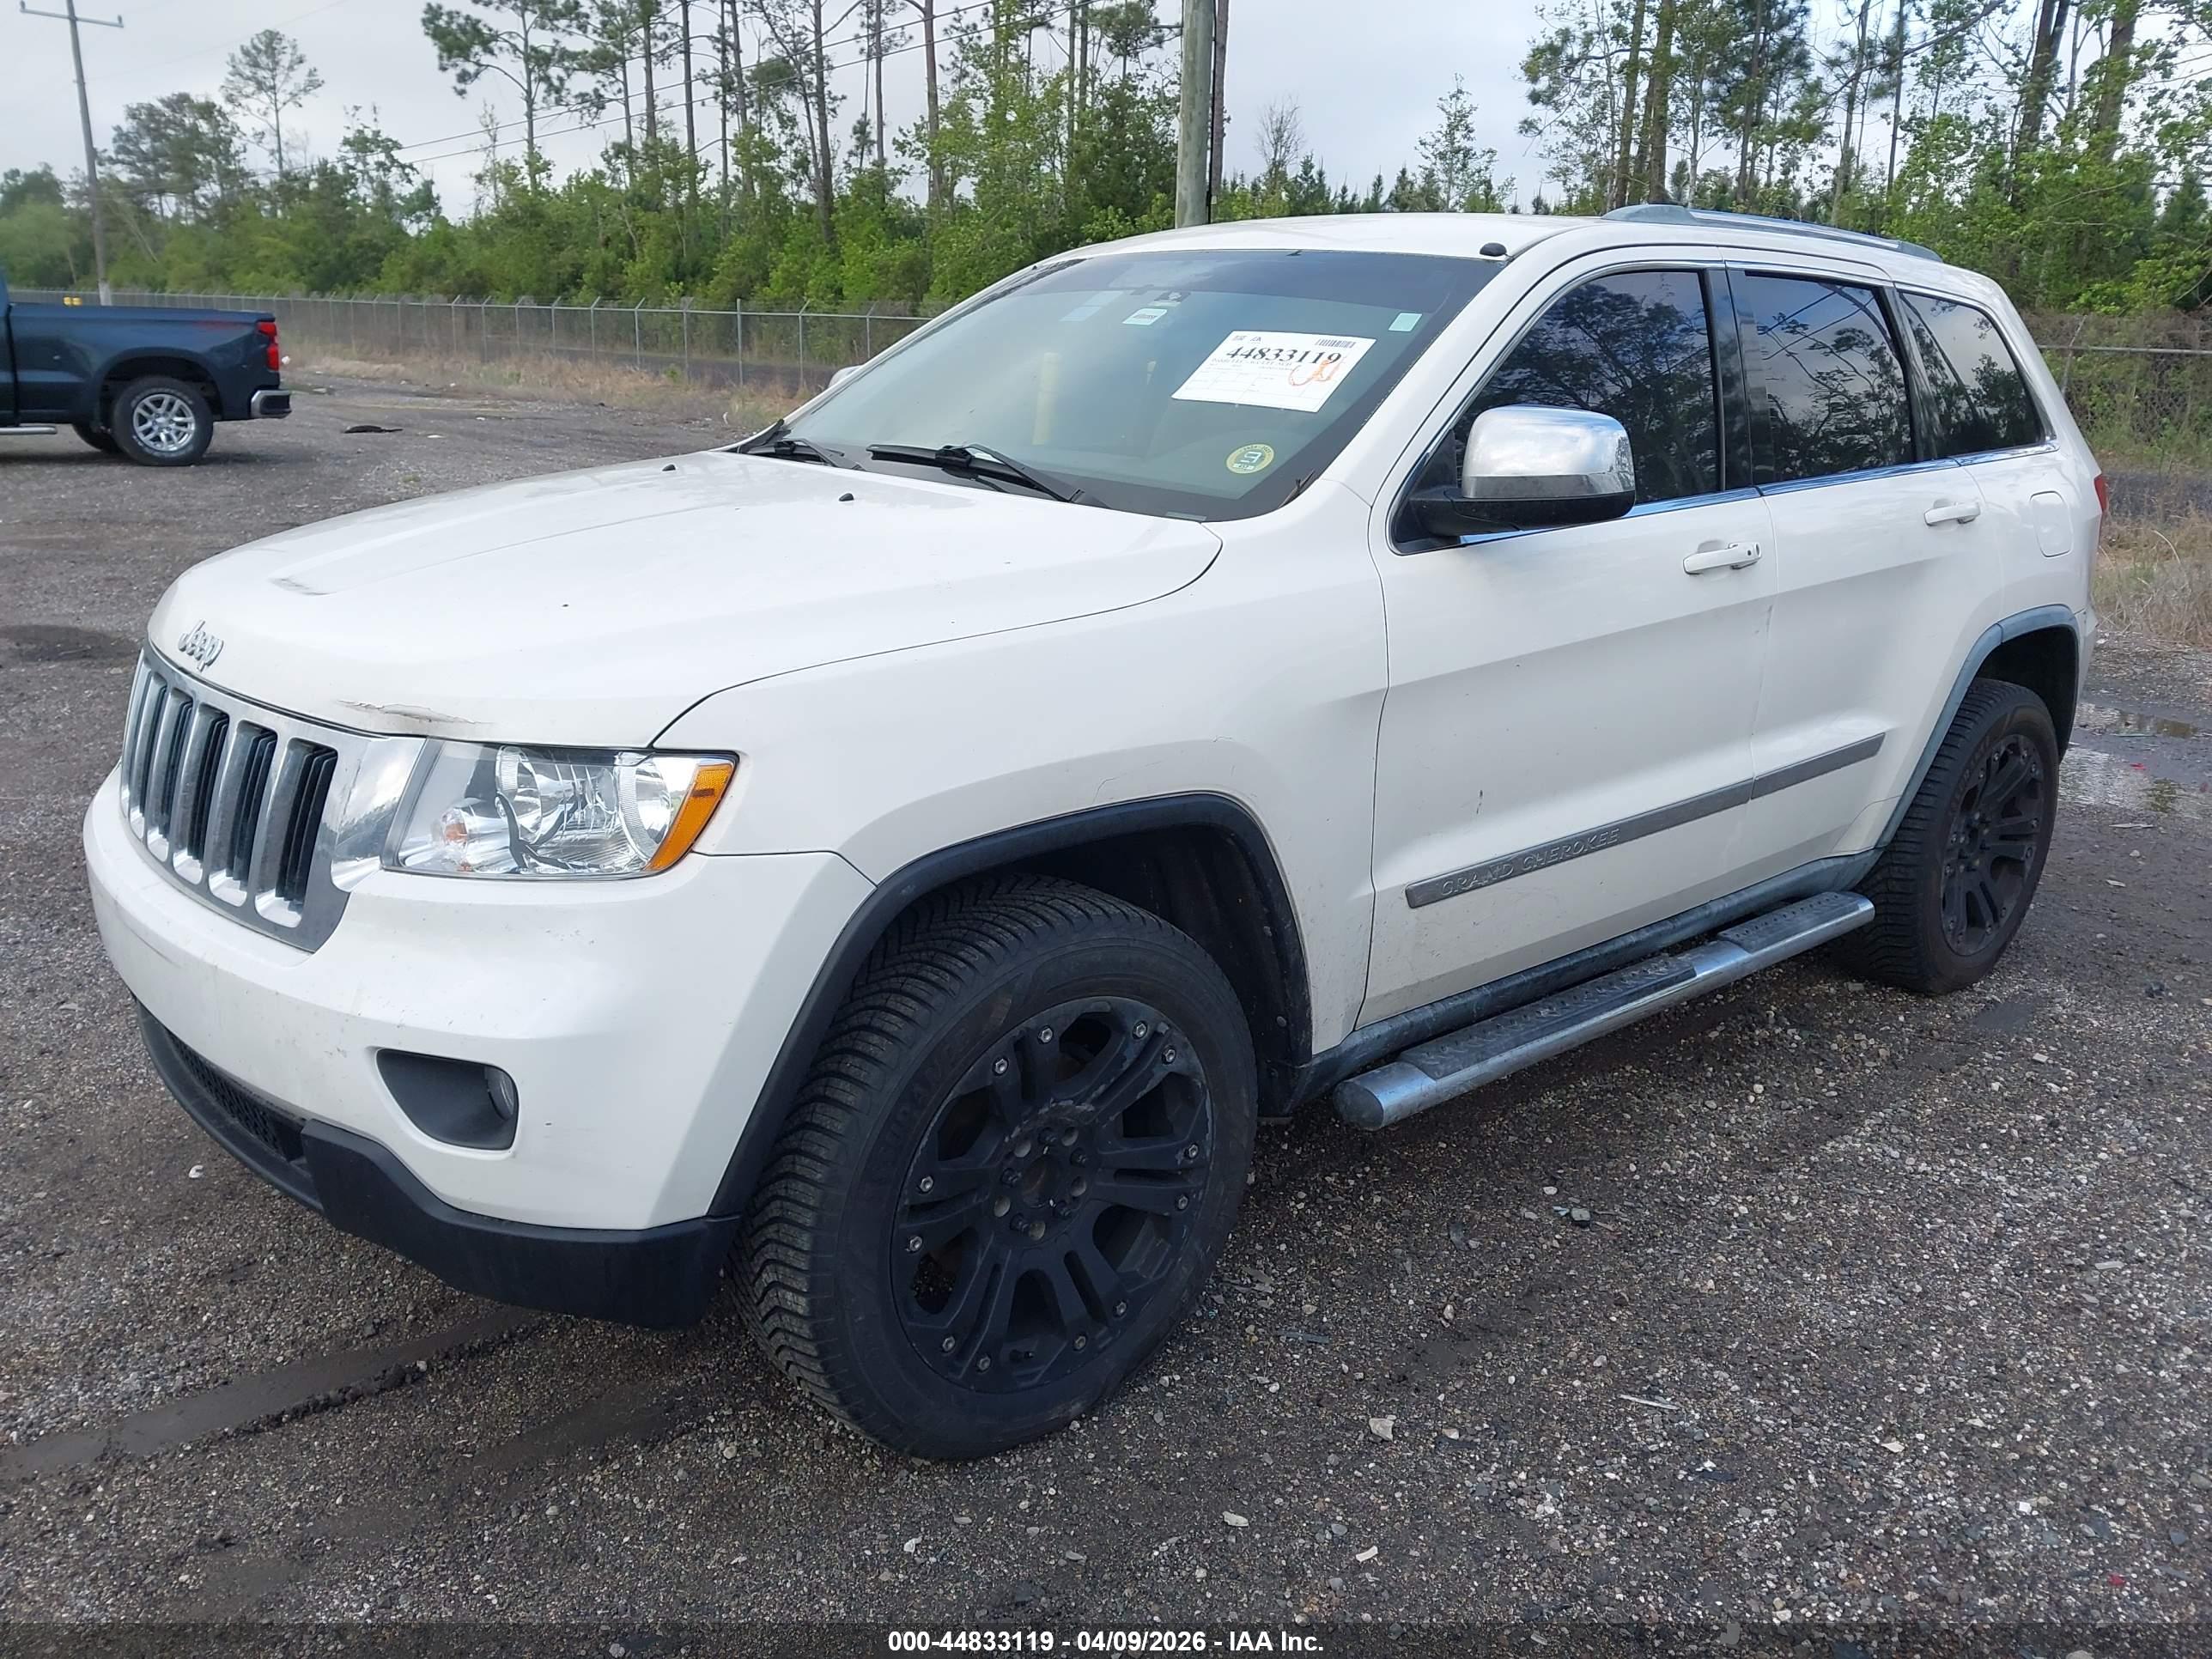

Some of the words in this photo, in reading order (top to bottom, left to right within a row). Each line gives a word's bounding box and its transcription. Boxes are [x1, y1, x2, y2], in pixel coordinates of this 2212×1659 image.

[1226, 346, 1341, 364] 44833119
[178, 618, 224, 672] Jeep
[1441, 863, 1514, 896] GRAND
[1522, 828, 1620, 871] CHEROKEE
